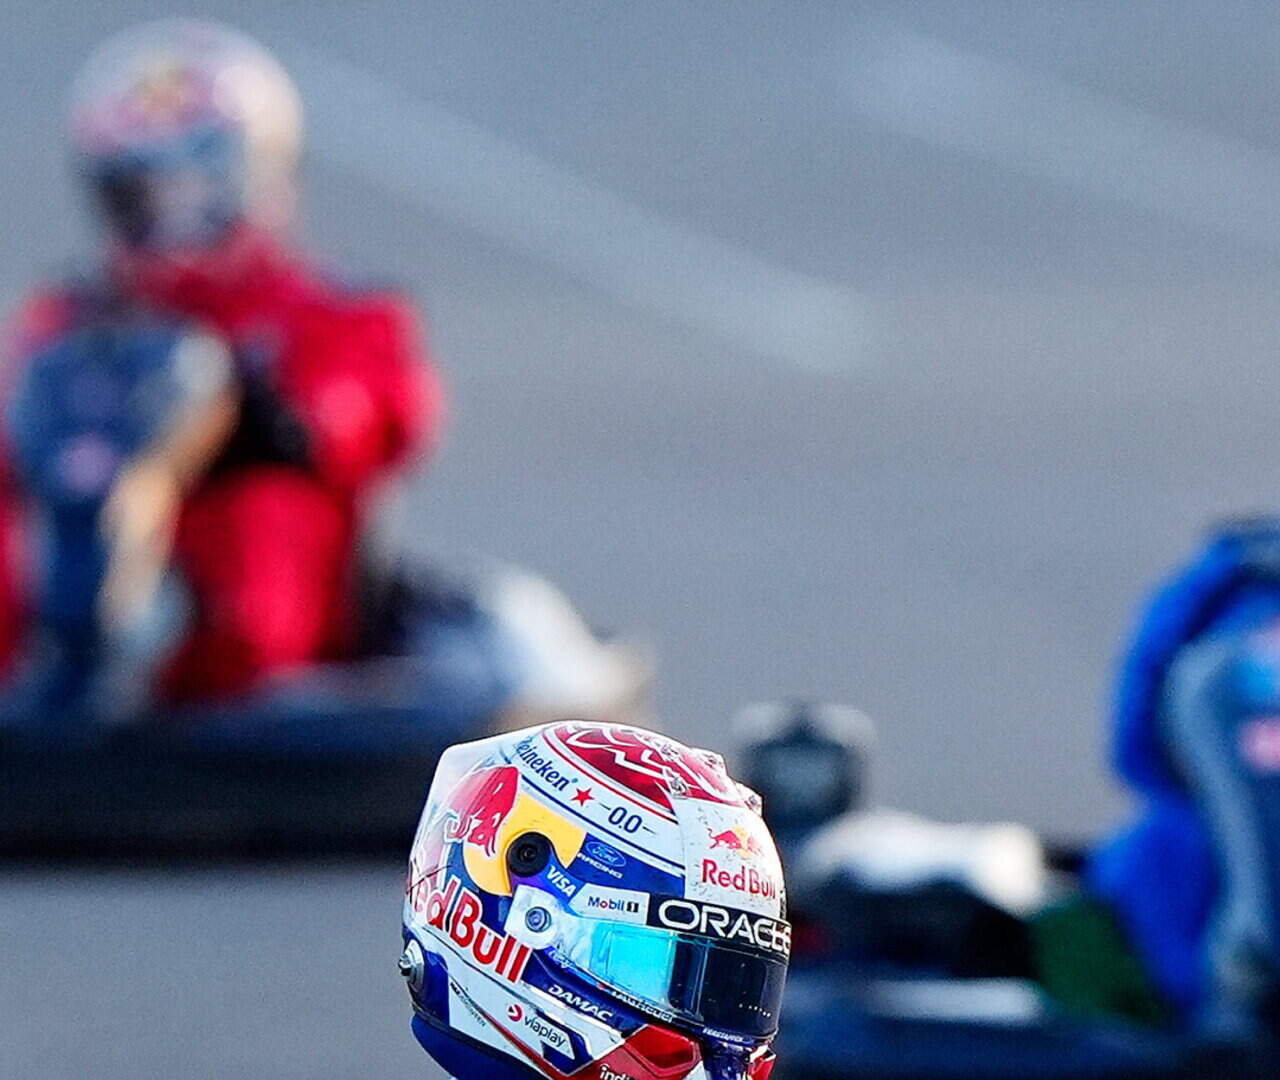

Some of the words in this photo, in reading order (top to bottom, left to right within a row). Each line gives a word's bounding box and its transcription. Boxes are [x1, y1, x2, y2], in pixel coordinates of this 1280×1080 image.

[546, 864, 577, 896] VISA
[702, 859, 746, 891] Red
[748, 868, 776, 899] Bull
[588, 896, 625, 911] Mobil
[449, 889, 530, 984] Bull
[658, 899, 792, 953] ORACLE
[548, 984, 613, 1021] DAMAC
[524, 1016, 566, 1048] viaplay
